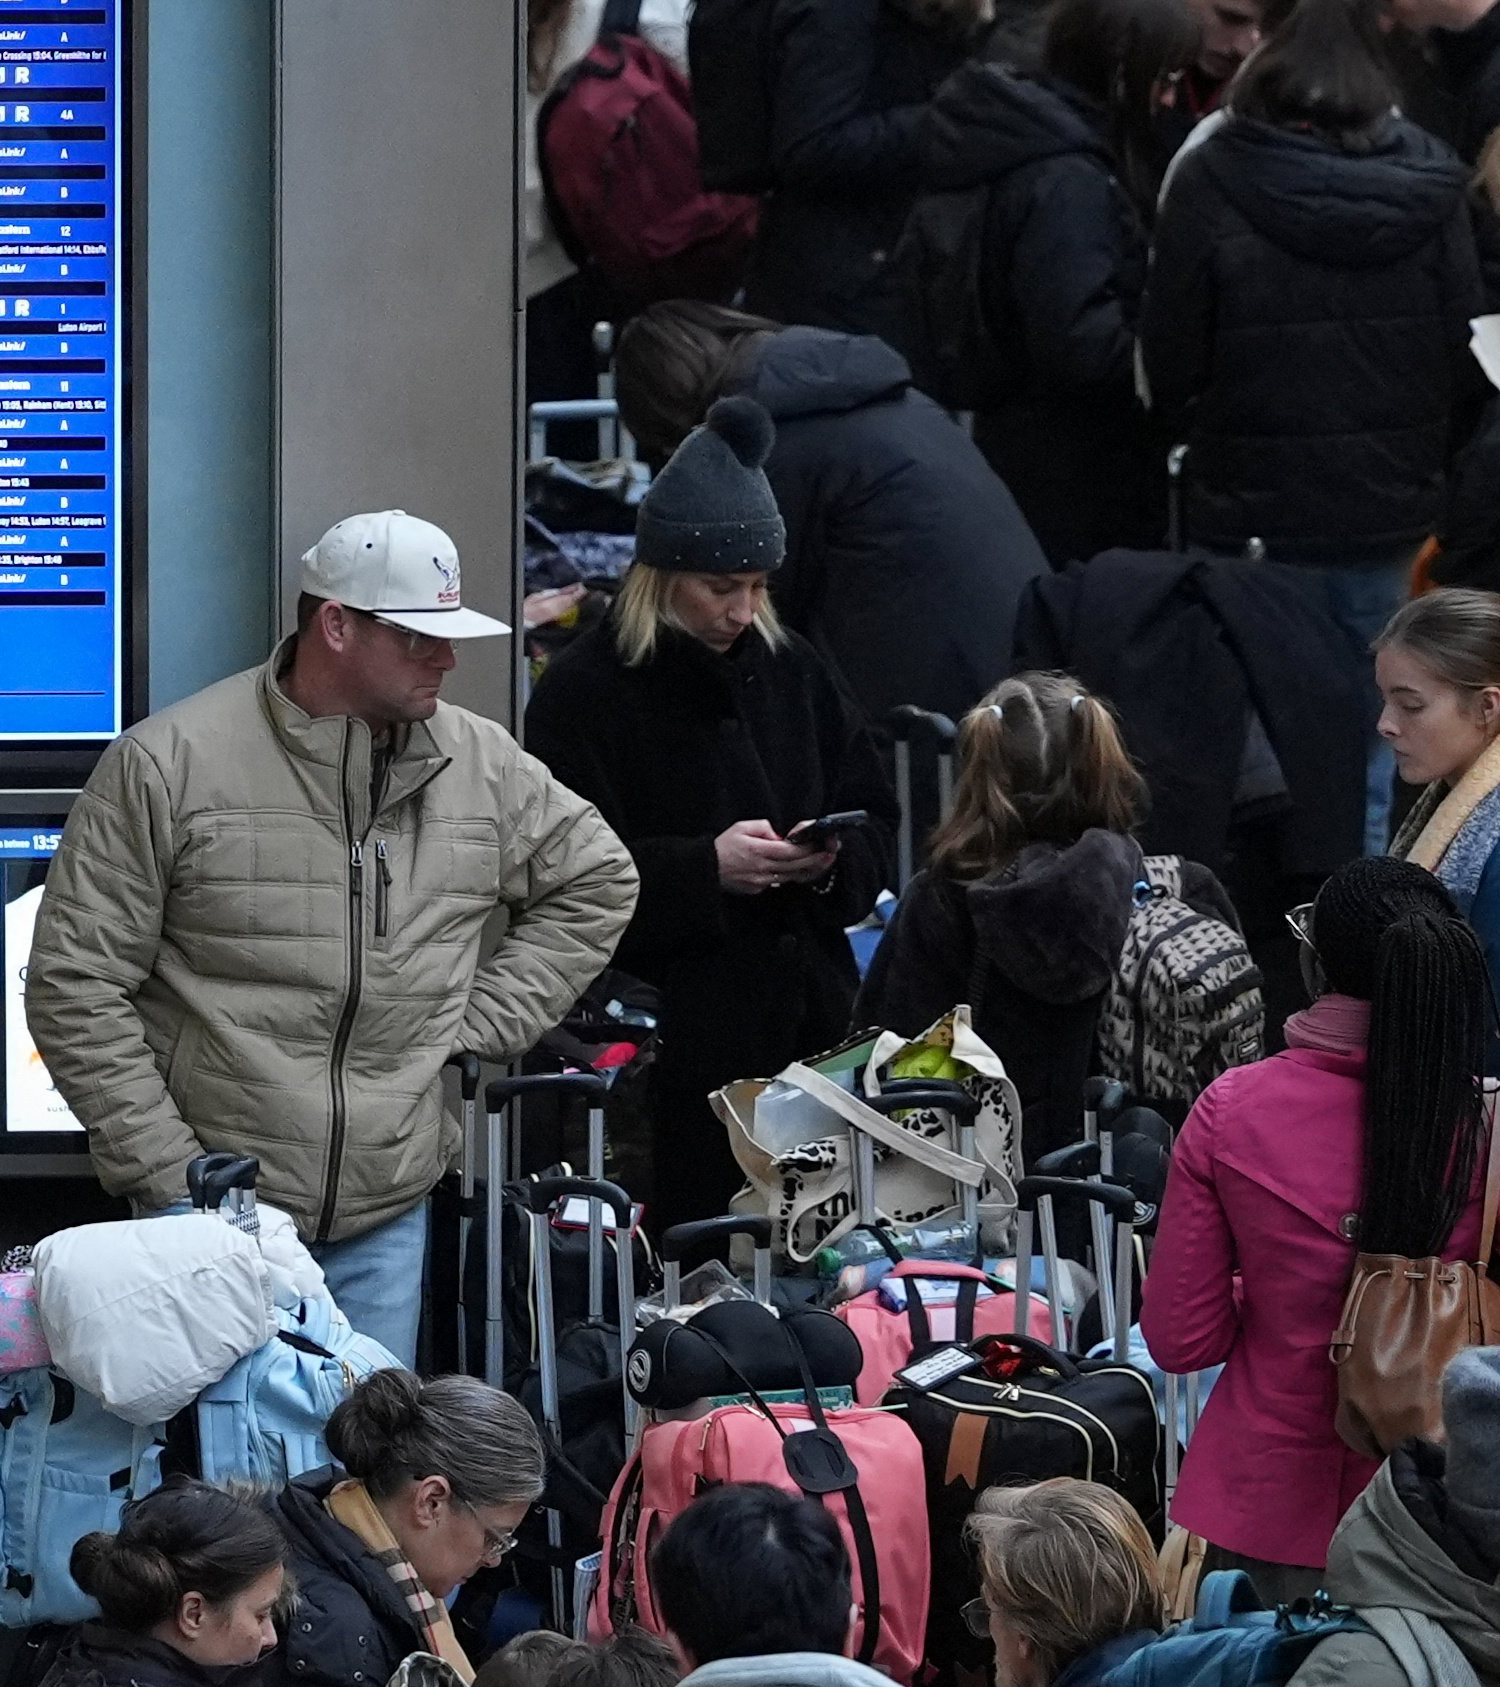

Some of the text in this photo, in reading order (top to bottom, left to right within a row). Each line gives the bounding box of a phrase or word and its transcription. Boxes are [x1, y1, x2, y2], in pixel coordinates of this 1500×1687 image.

[60, 31, 68, 42] A
[60, 109, 74, 120] 4A
[60, 148, 68, 158] A
[60, 225, 71, 236] 12
[32, 834, 62, 850] 13:5
